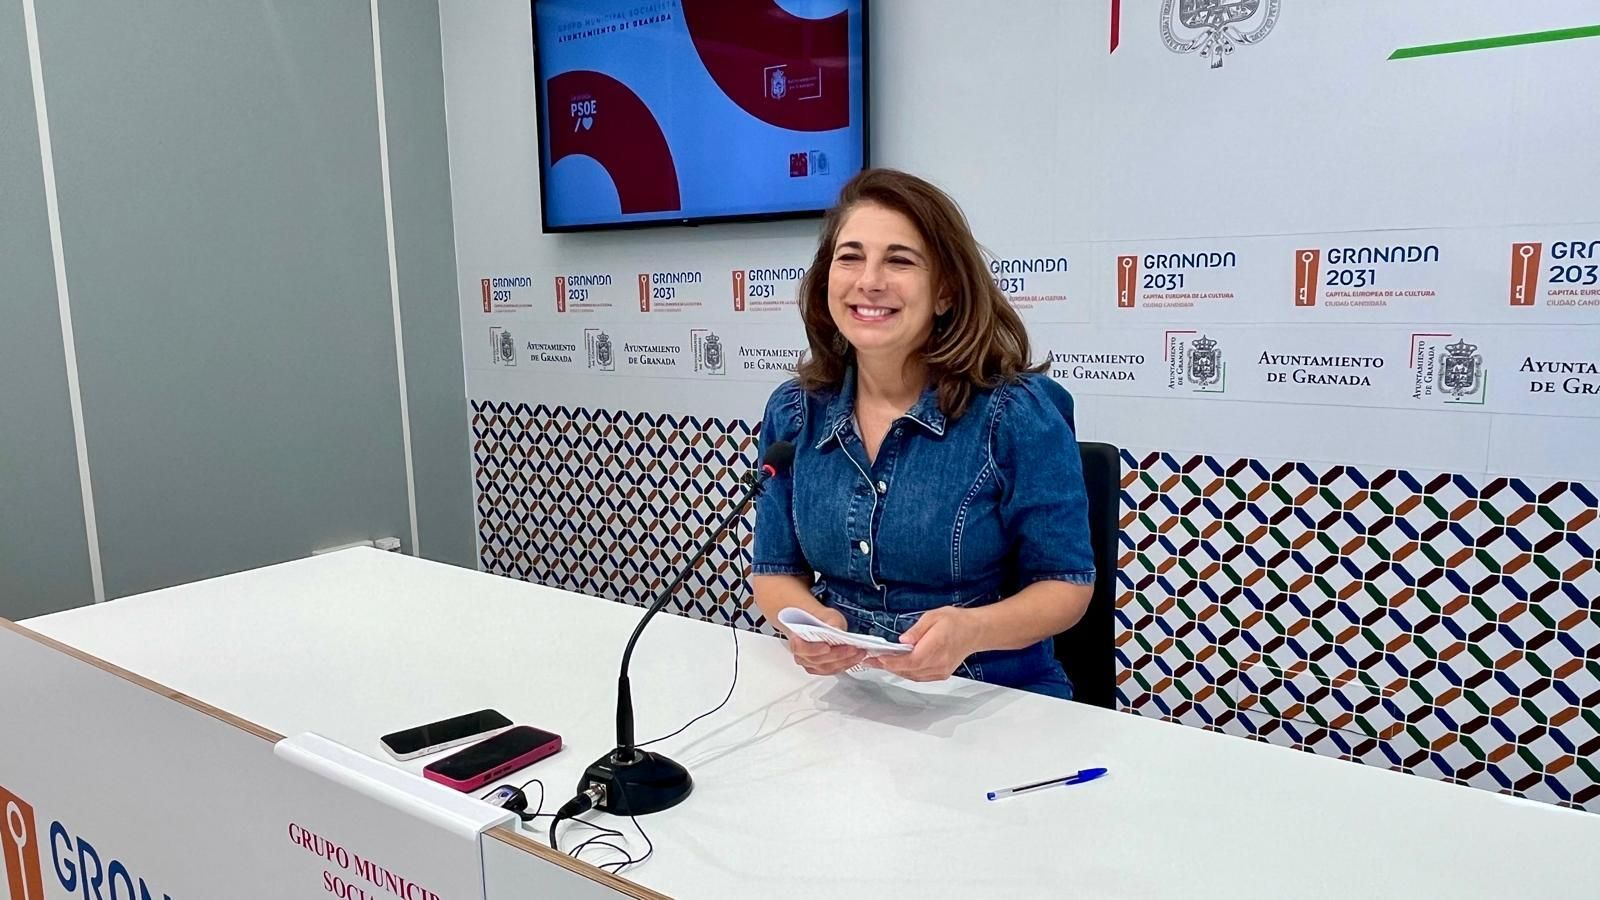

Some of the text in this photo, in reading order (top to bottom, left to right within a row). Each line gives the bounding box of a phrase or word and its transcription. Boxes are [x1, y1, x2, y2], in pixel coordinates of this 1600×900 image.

[632, 13, 672, 27] GRANADA
[571, 100, 597, 117] PSOE
[1143, 252, 1236, 269] GRANADA
[1327, 245, 1439, 264] GRANADA
[990, 258, 1067, 273] GRANADA
[567, 274, 612, 287] GRANADA
[652, 271, 702, 284] GRANADA
[748, 267, 805, 281] GRANADA
[1325, 269, 1376, 288] 2031
[492, 277, 531, 288] GRANADA
[1143, 274, 1185, 290] 2031
[493, 290, 512, 302] 2031
[568, 289, 589, 301] 2031
[653, 287, 676, 299] 2031
[748, 284, 775, 298] 2031
[526, 342, 576, 351] AYUNTAMIENTO
[623, 342, 680, 354] AYUNTAMIENTO
[738, 345, 803, 358] AYUNTAMIENT
[540, 353, 572, 363] GRANADA
[639, 354, 676, 366] GRANADA
[1047, 350, 1145, 365] AYUNTAMIENTO
[1258, 351, 1384, 368] AYUNTAMIENTO
[743, 361, 755, 370] DE
[1052, 366, 1136, 381] DE GRANADA
[1267, 370, 1371, 386] DE GRANADA
[1425, 385, 1433, 395] DE
[1530, 381, 1556, 393] DE
[288, 822, 349, 869] GRUPO
[50, 821, 171, 900] GRA
